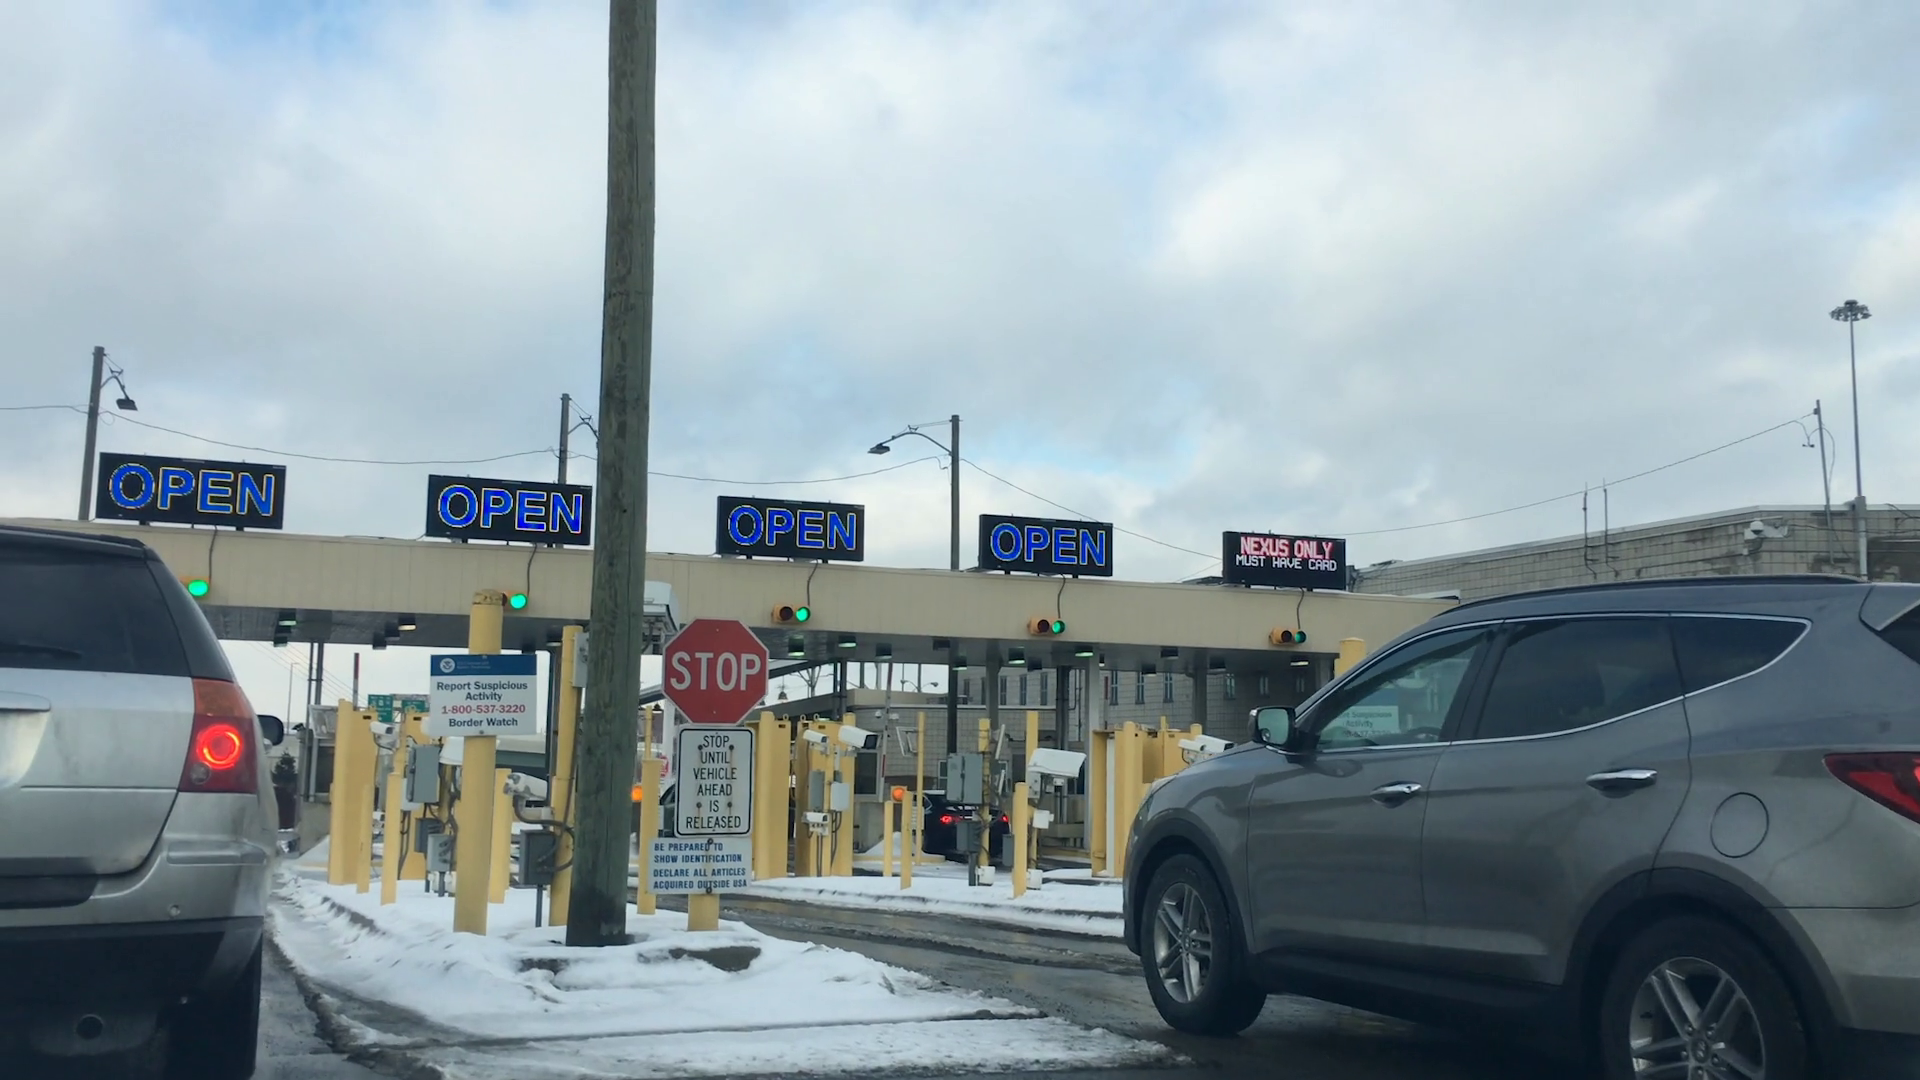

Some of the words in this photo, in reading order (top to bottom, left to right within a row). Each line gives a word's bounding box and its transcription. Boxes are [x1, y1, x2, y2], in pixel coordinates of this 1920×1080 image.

[109, 463, 275, 516] OPEN
[438, 484, 583, 534] OPEN
[728, 505, 857, 550] OPEN
[990, 523, 1105, 566] OPEN
[1241, 536, 1290, 557] NEXUS
[1293, 540, 1333, 560] ONLY
[1236, 554, 1266, 567] MUST
[1272, 557, 1302, 569] HAVE
[1308, 559, 1337, 571] CARD
[670, 651, 761, 691] STOP
[436, 682, 471, 692] Report
[473, 680, 528, 691] Suspicious
[465, 691, 503, 702] Activity
[441, 704, 526, 714] 1-800-537-3220
[449, 718, 482, 727] Border
[486, 717, 518, 727] Watch
[702, 735, 730, 748] STOP
[701, 752, 730, 764] UNTIL
[693, 767, 737, 780] VEHICLE
[697, 784, 732, 796] AHEAD
[709, 800, 719, 813] IS
[686, 816, 741, 829] RELEASED
[654, 843, 665, 851] BE
[668, 843, 710, 851] PREPARED
[714, 843, 723, 851] TO
[654, 855, 678, 863] SHOW
[682, 854, 742, 863] IDENTIFICATION
[653, 869, 689, 877] DECLARE
[693, 868, 708, 877] ALL
[711, 867, 746, 876] ARTICLES
[653, 881, 694, 890] ACQUIRED
[697, 880, 730, 889] OUTSIDE
[733, 879, 747, 887] USA
